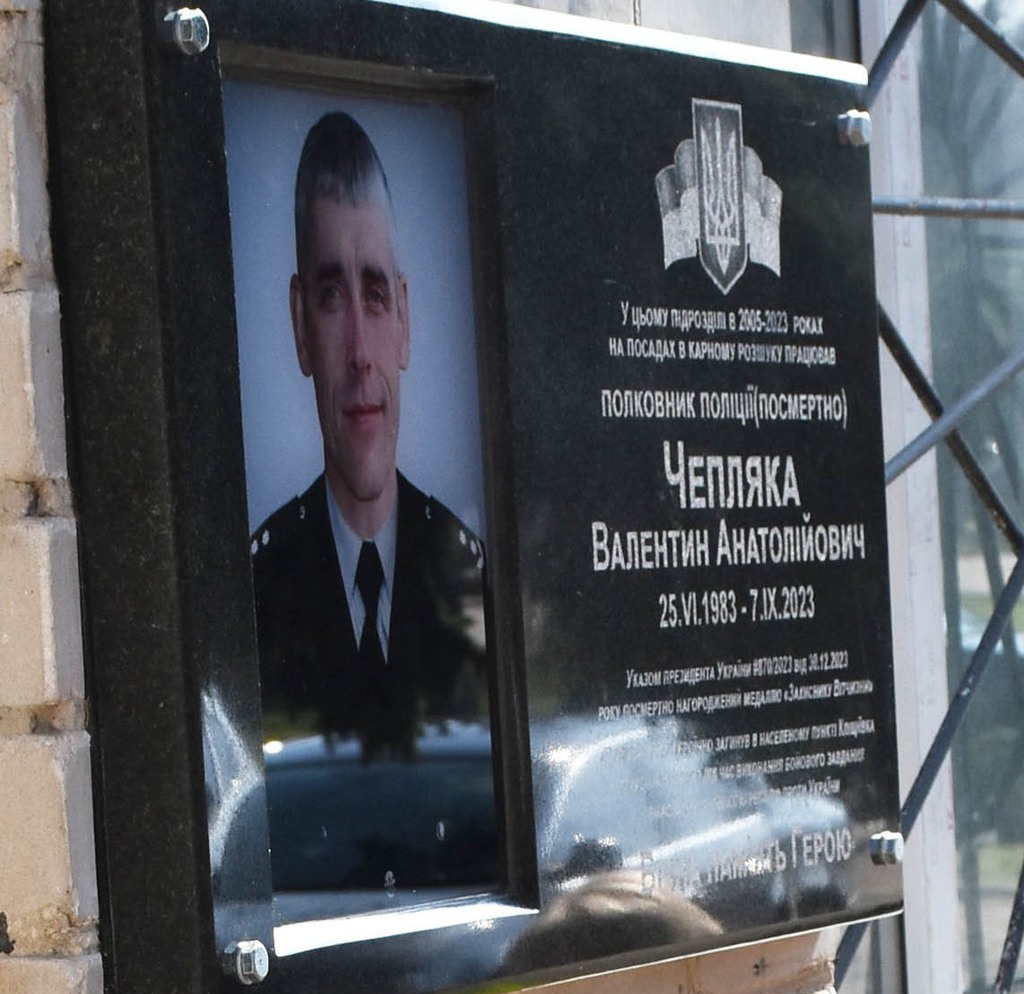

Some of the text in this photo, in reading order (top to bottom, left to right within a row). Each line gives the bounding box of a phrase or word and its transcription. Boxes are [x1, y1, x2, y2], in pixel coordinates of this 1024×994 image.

[620, 301, 629, 325] У
[793, 316, 824, 335] РОКАХ
[609, 337, 837, 367] НА ПОСАДАХ В КАРНОМУ РОЗШУКУ ПРАЦЮВАВ
[601, 388, 696, 419] ПОЛКОВНИК
[662, 440, 801, 509] ЧЕПЛЯКА
[591, 512, 865, 571] ВАЛЕНТИН АНАТОЛІЙОВИЧ
[658, 588, 737, 629] 25.VI.1983
[749, 584, 816, 622] 7.IX.2023
